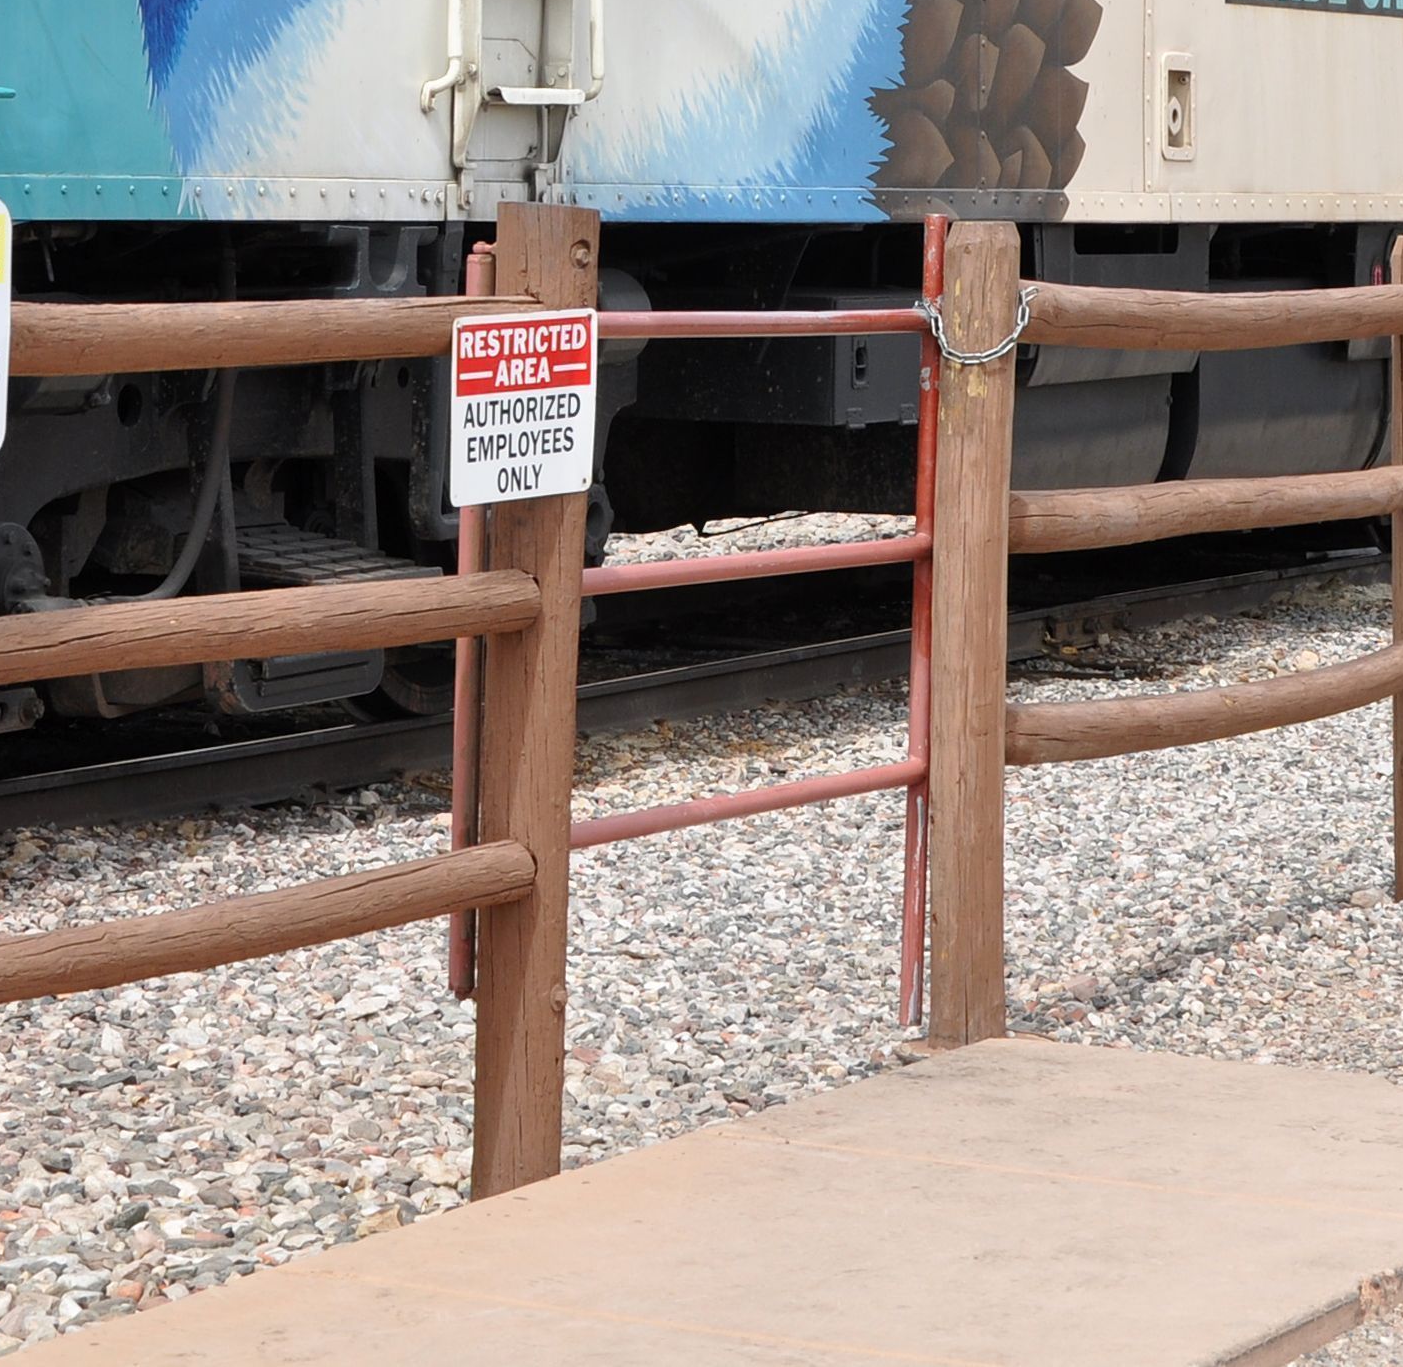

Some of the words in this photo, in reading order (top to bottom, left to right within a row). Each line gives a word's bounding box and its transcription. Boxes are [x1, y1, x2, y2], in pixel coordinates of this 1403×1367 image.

[460, 323, 587, 359] RESTRICTED
[495, 356, 550, 387] AREA
[464, 393, 581, 429] AUTHORIZED
[467, 427, 574, 463] EMPLOYEES
[498, 464, 543, 493] ONLY
